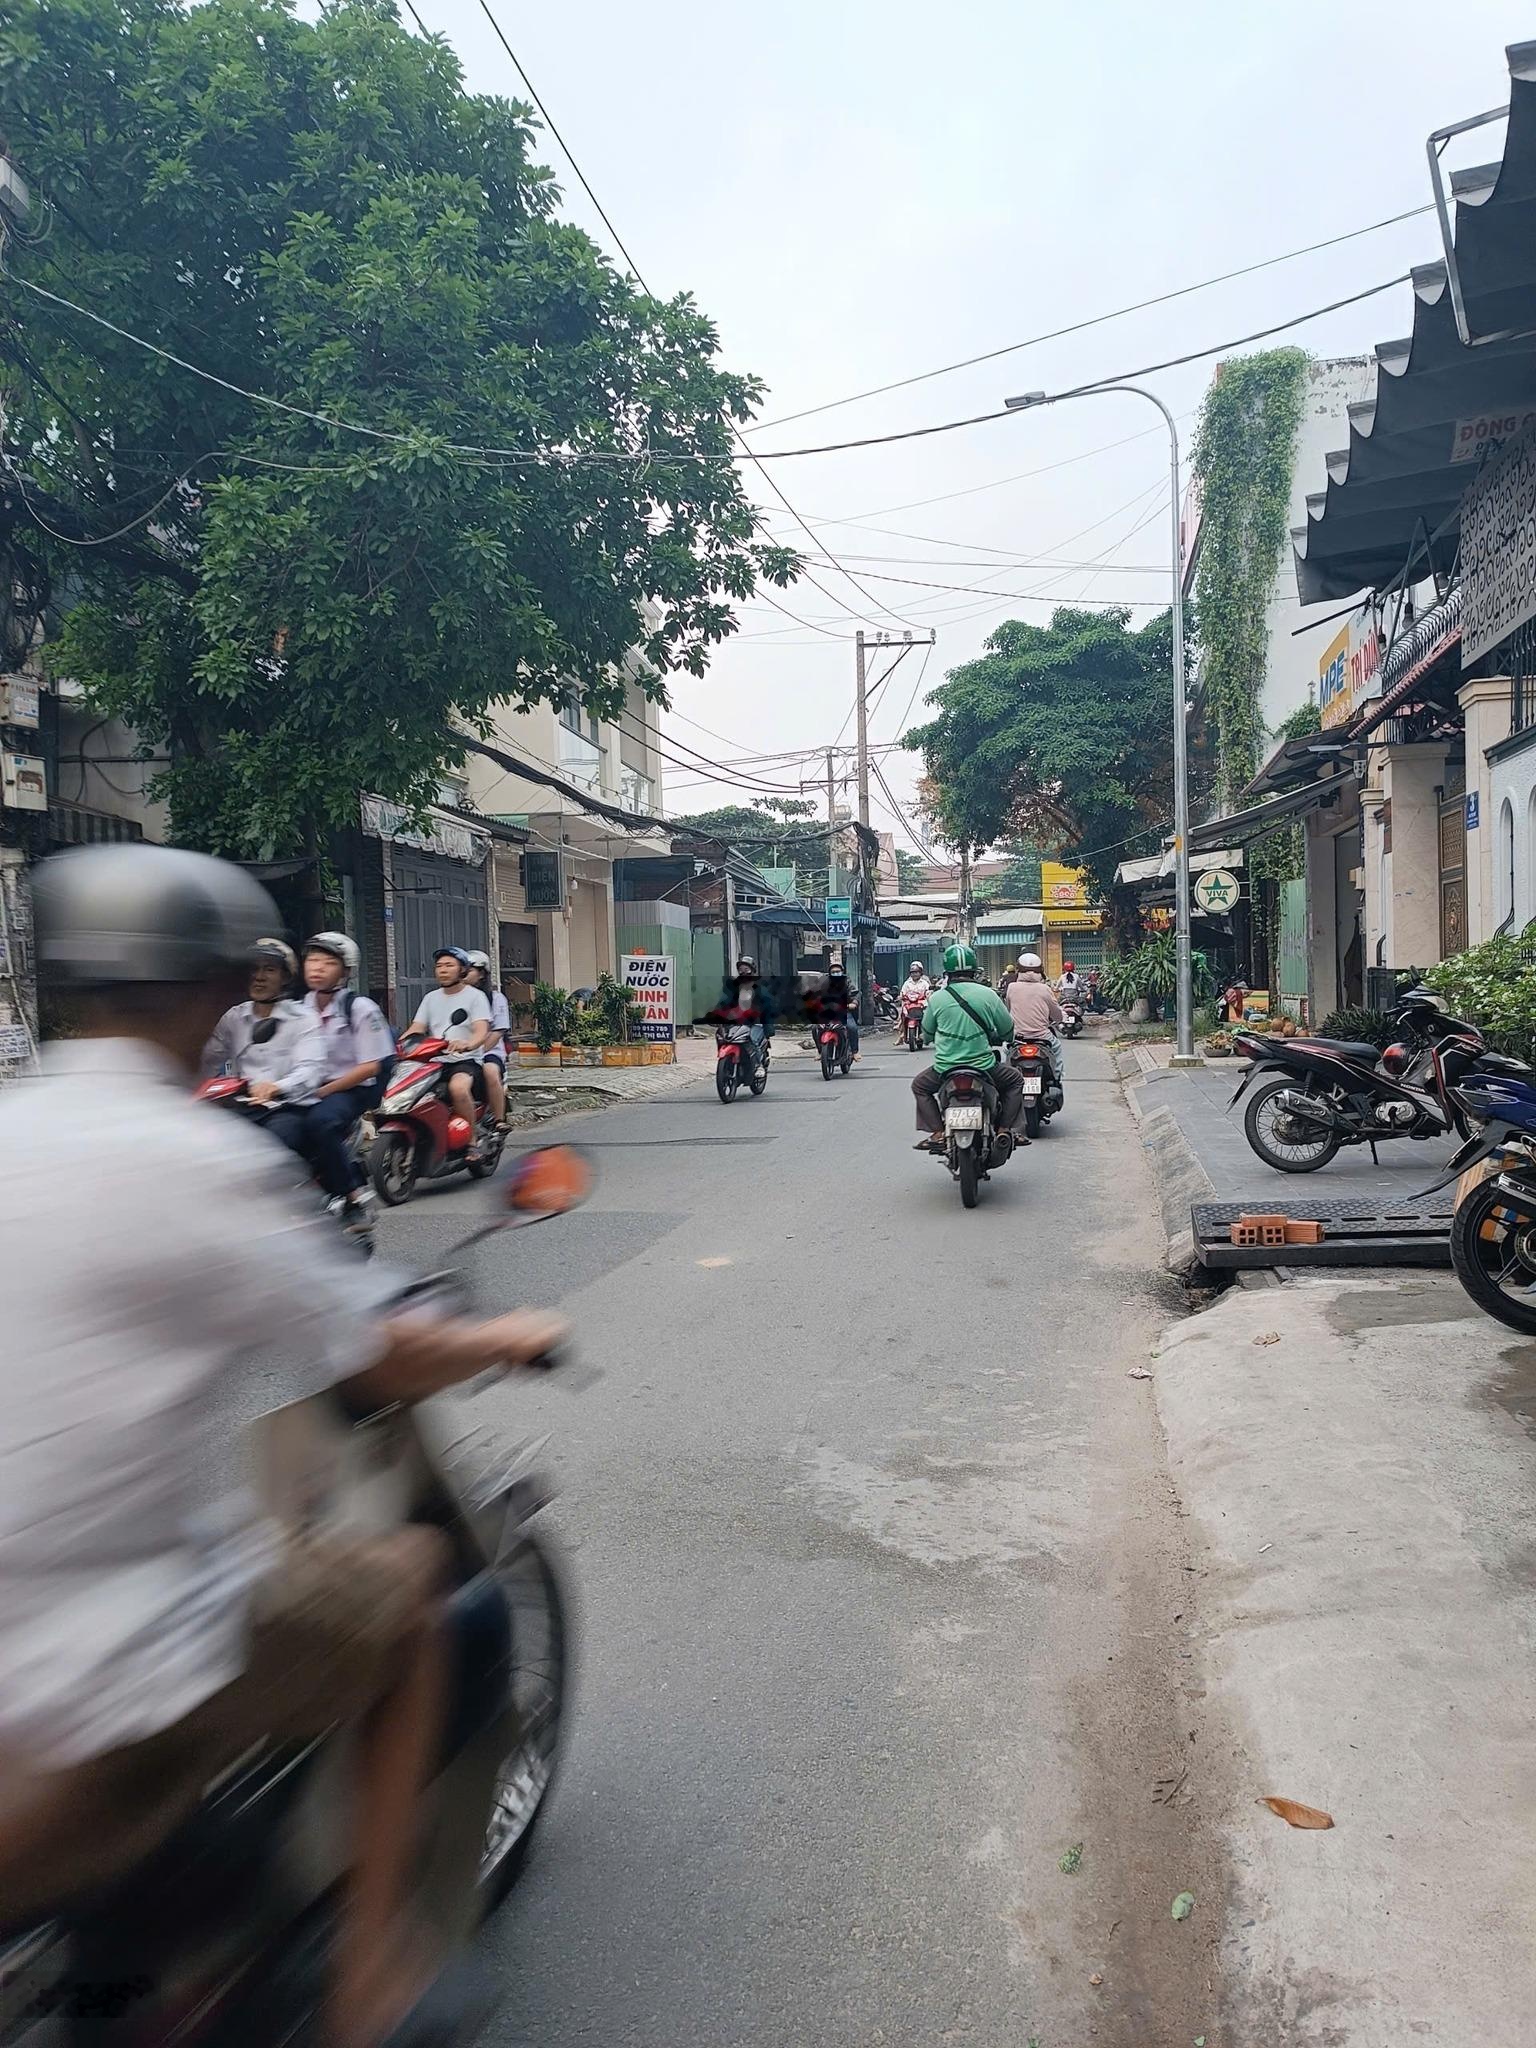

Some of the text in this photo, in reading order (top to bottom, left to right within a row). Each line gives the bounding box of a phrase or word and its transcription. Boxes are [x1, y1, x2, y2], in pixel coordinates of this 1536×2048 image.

[1206, 889, 1229, 897] VIVA
[828, 925, 849, 933] 2 LY
[628, 960, 667, 975] ĐIỆN
[625, 974, 670, 987] NƯỚC
